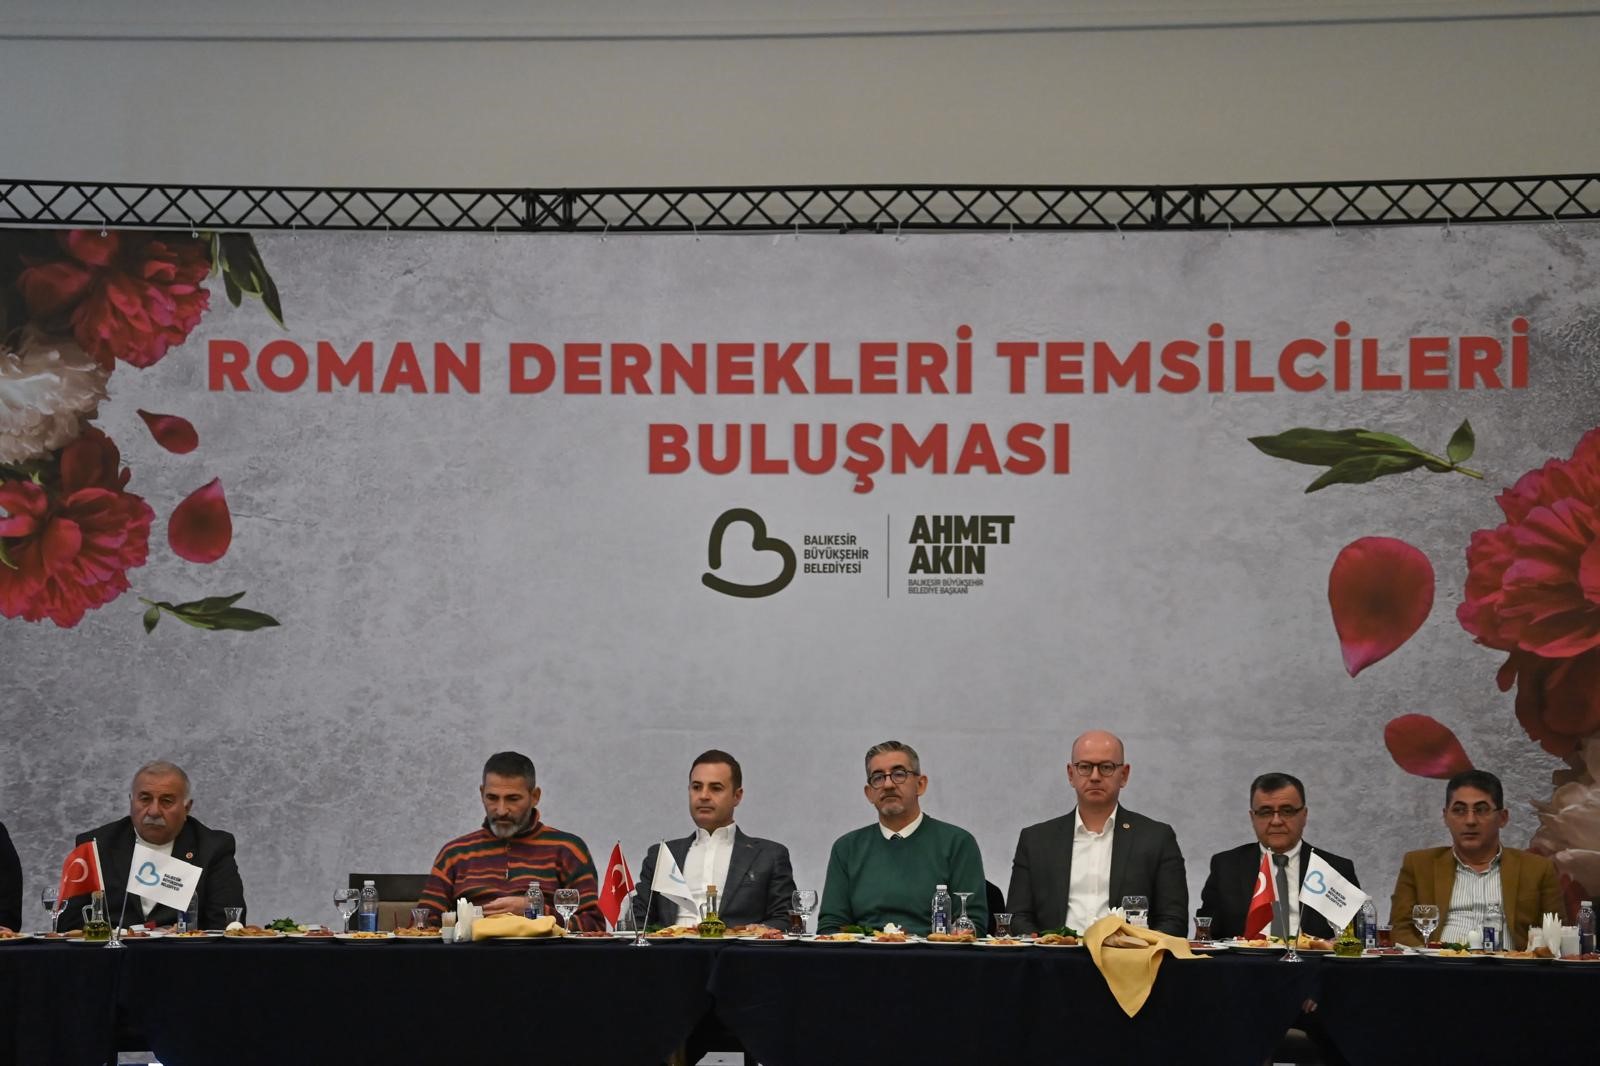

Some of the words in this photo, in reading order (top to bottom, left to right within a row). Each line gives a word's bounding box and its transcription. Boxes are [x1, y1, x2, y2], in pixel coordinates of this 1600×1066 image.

[208, 339, 481, 394] ROMAN
[509, 325, 973, 394] DERNEKLERİ
[996, 318, 1529, 394] TEMSİLCİLERİ
[648, 422, 1071, 494] BULUŞMASI
[804, 532, 857, 545] BALIKESİR
[908, 514, 1016, 545] AHMET
[804, 546, 869, 562] BÜYÜKŞEHİR
[804, 560, 862, 574] BELEDİYESİ
[908, 545, 986, 575] AKIN
